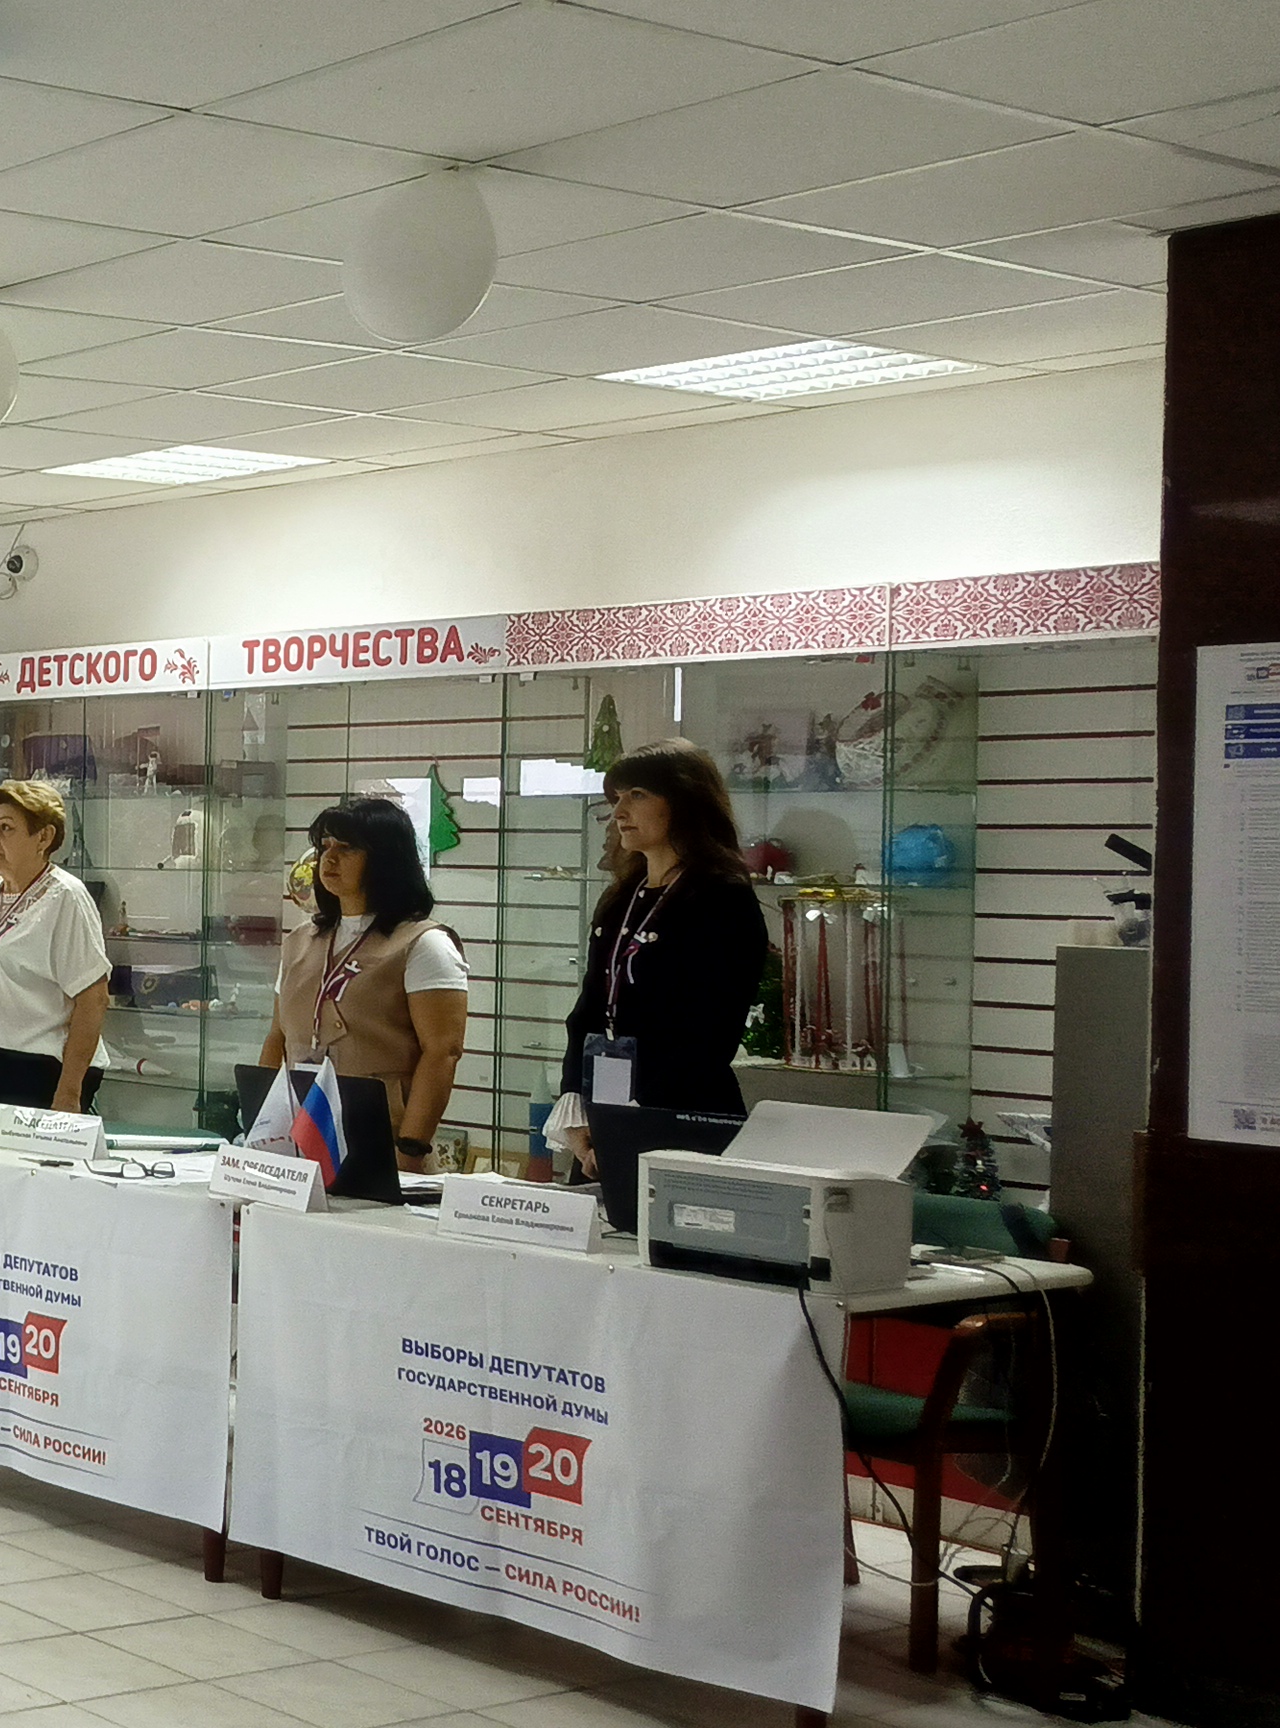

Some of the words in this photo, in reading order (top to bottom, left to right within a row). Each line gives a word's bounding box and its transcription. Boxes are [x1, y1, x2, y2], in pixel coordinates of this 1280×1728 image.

[16, 648, 157, 694] ДЕТСКОГО
[242, 625, 465, 675] ТВОРЧЕСТВА
[13, 1116, 80, 1133] ПДСЕДАТЕЛЬ
[481, 1195, 550, 1214] СЕКРЕТАРЬ
[491, 1214, 514, 1225] Елена
[3, 1253, 79, 1282] ДЕПУТАТОВ
[45, 1289, 81, 1307] ДУМЫ
[25, 1325, 55, 1359] 20
[402, 1337, 483, 1369] ВЫБОРЫ
[489, 1355, 606, 1393] ДЕПУТАТОВ
[397, 1367, 557, 1412] ГОСУДАРСТВЕННОЙ
[561, 1401, 608, 1425] ДУМЫ
[13, 1425, 40, 1448] СИЛА
[43, 1437, 107, 1465] РОССИИ!
[423, 1417, 467, 1440] 2026
[428, 1459, 467, 1498] 18
[475, 1450, 518, 1489] 19
[527, 1442, 578, 1486] 20
[480, 1505, 583, 1546] СЕНТЯБРЯ
[364, 1526, 412, 1554] ТВОЙ
[417, 1541, 479, 1572] ГОЛОС
[505, 1564, 557, 1593] СИЛА
[562, 1580, 640, 1623] РОССИИ!
